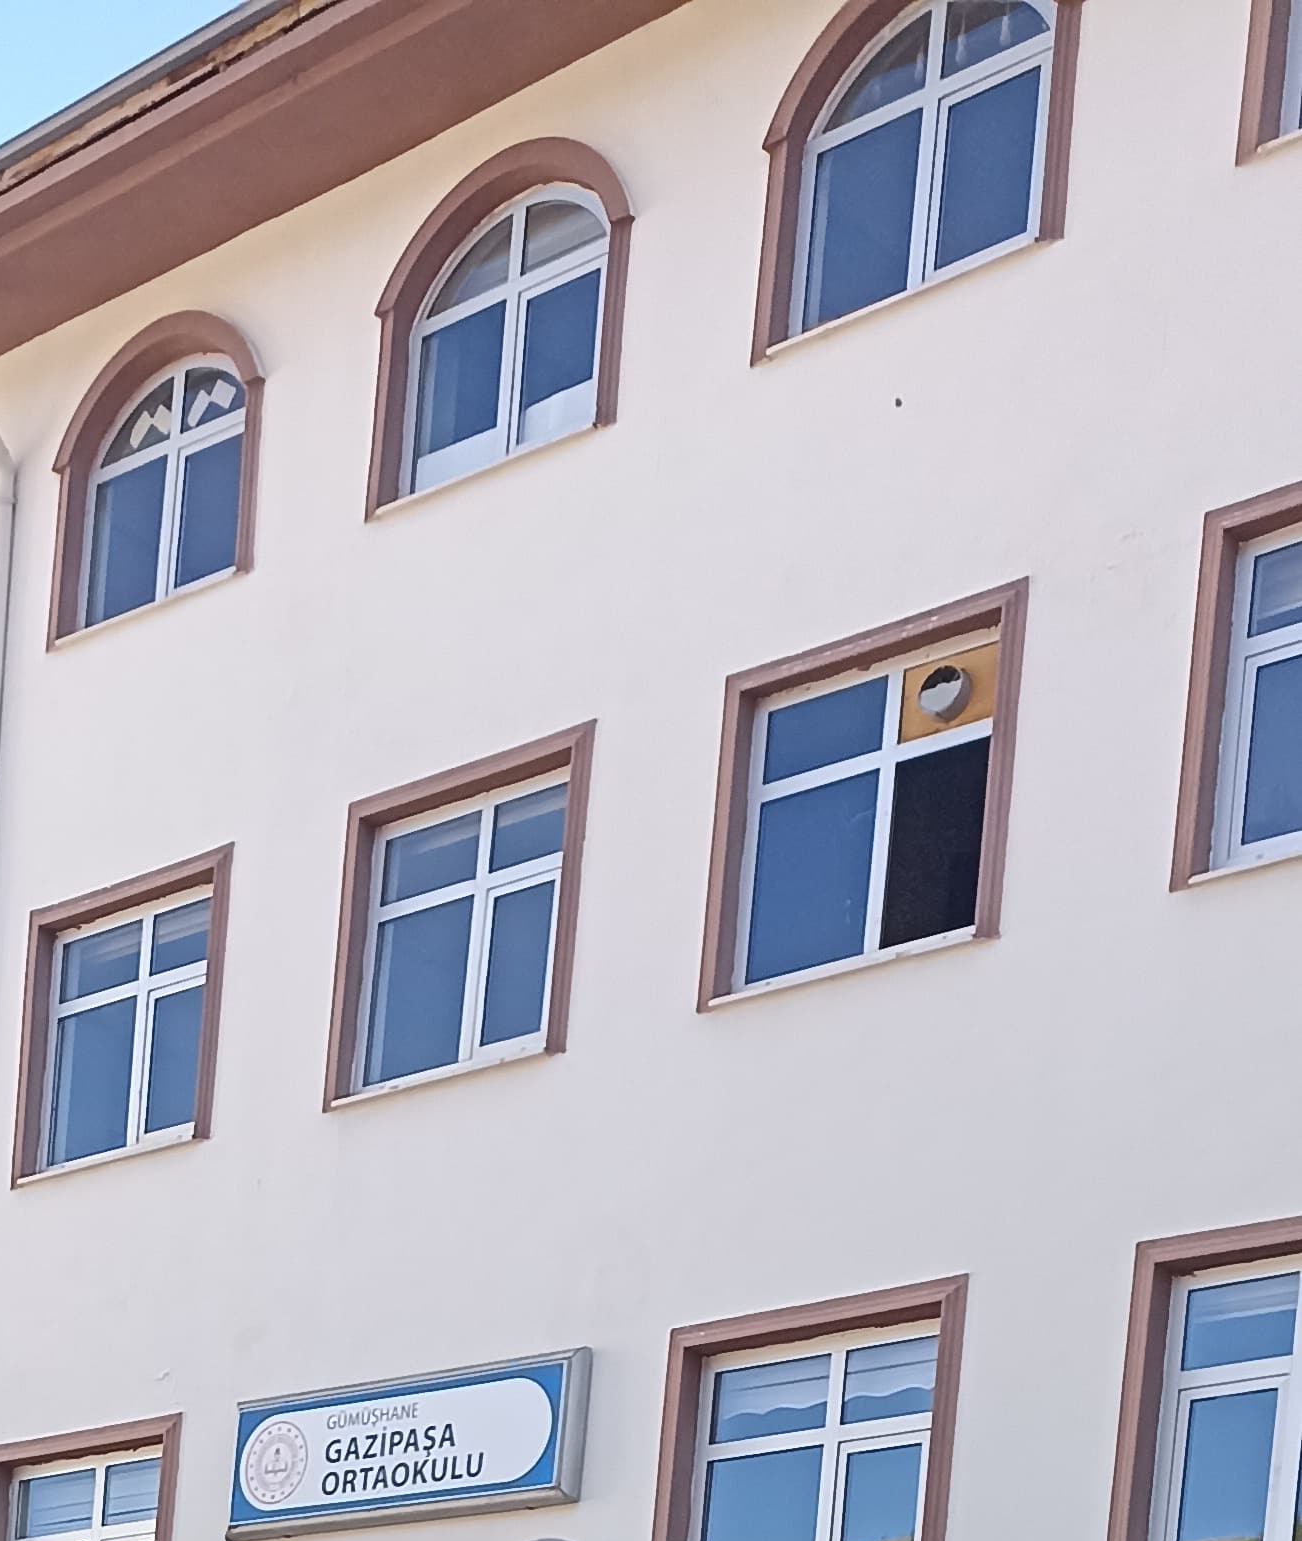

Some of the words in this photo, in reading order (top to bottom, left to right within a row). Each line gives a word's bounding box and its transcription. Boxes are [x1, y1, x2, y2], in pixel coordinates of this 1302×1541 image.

[326, 1402, 419, 1430] GÜMÜŞHANE
[324, 1423, 457, 1463] GAZİPAŞA
[321, 1451, 485, 1496] ORTAOKULU
